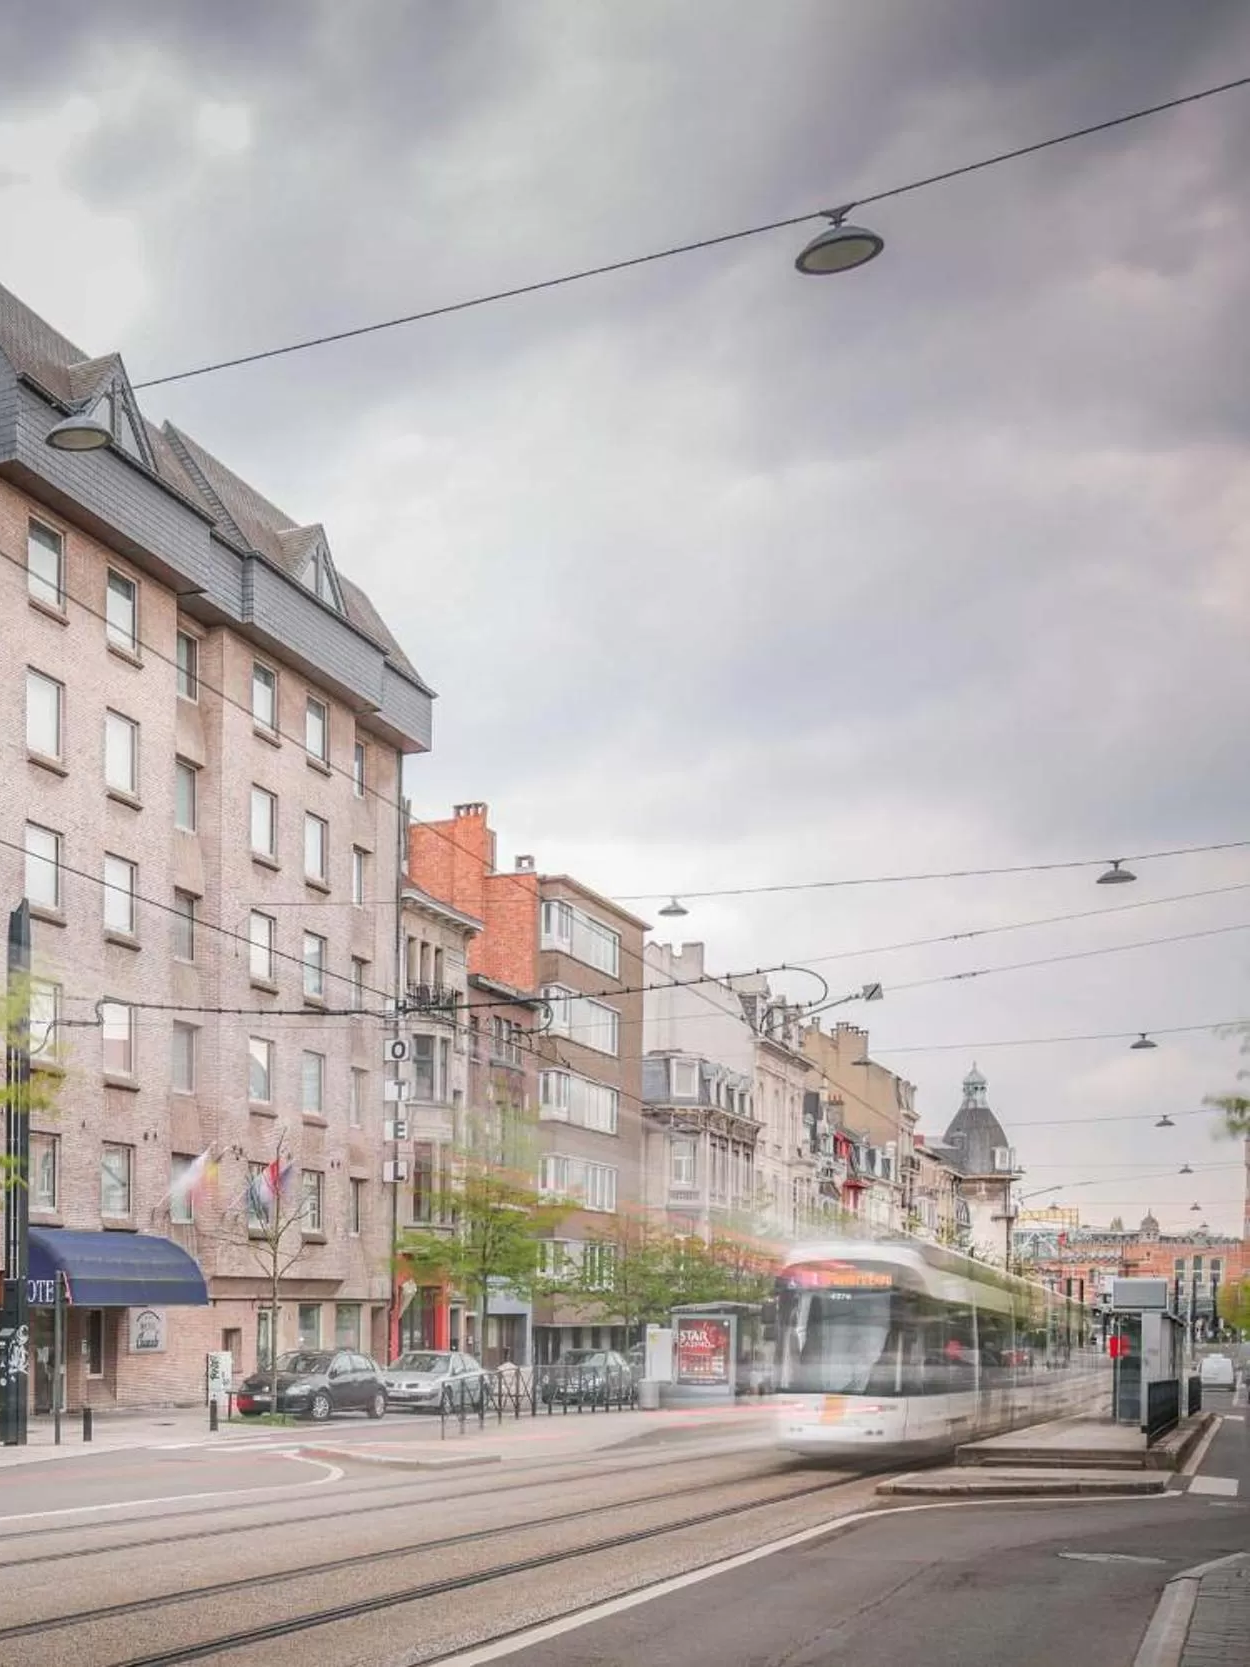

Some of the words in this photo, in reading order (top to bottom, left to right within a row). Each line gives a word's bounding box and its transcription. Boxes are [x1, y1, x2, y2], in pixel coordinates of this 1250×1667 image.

[391, 998, 407, 1180] HOTEL
[26, 1279, 54, 1303] OTE
[680, 1329, 709, 1343] STAR
